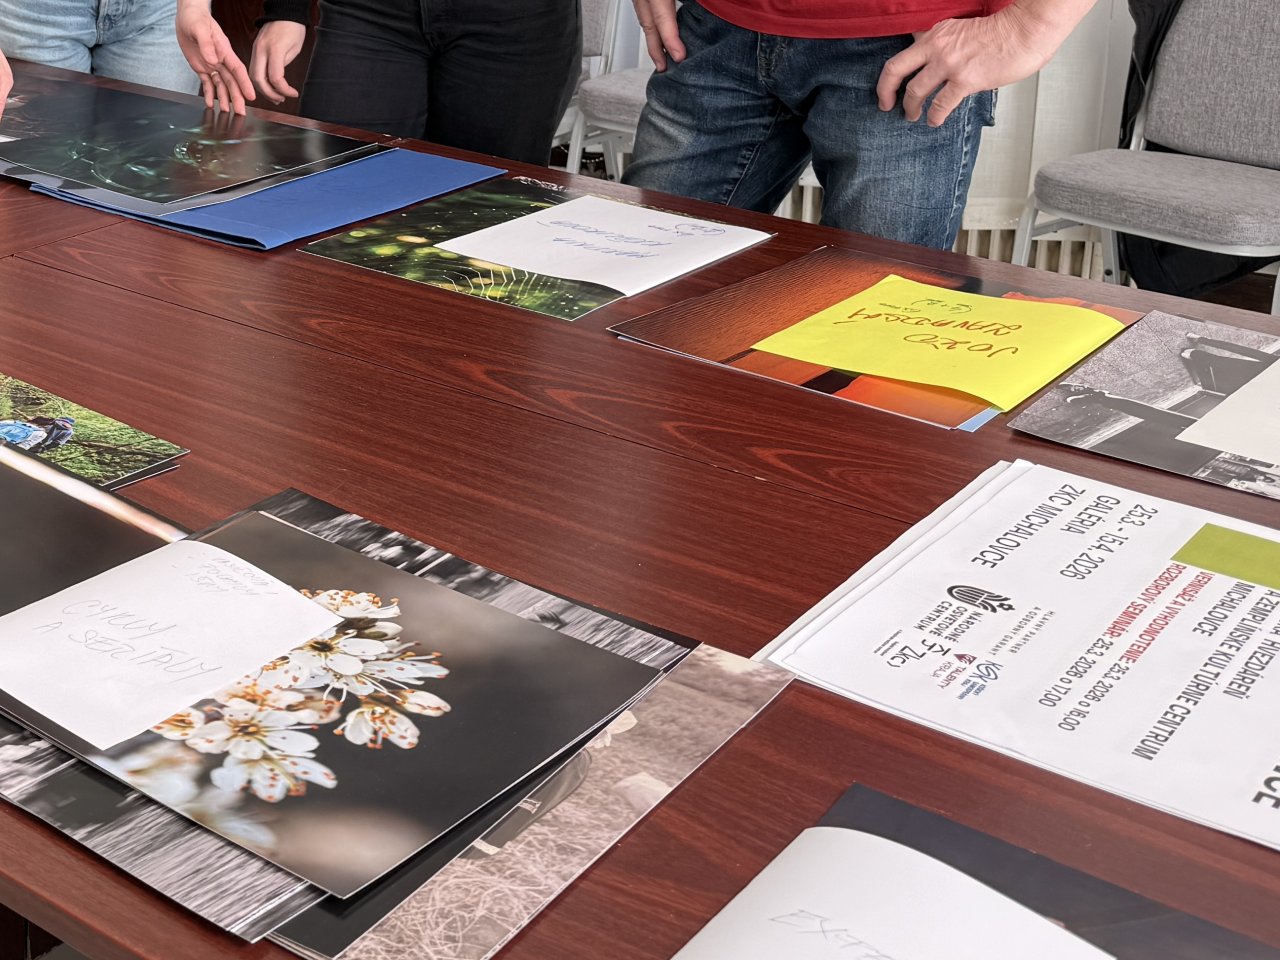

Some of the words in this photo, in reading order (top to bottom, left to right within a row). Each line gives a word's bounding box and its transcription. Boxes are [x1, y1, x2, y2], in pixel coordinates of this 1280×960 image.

[1048, 484, 1086, 506] ZKC
[1060, 495, 1121, 534] GALÉRIA
[1117, 504, 1159, 527] 25.3.
[971, 503, 1063, 569] MICHALOVCE
[1087, 532, 1129, 553] 15.4.
[1060, 552, 1105, 580] 2026
[1137, 562, 1188, 604] ROZBOROVÝ
[1175, 571, 1215, 602] VERNISÁŽ
[1264, 589, 1280, 598] A
[62, 600, 177, 637] CYKLY
[913, 600, 953, 631] CENTRUM
[928, 606, 968, 637] OSVETOVÉ
[1031, 610, 1056, 631] HLAVNÝ
[1102, 601, 1148, 639] SEMINÁR:
[1192, 581, 1256, 637] MICHALOVCE
[33, 621, 63, 634] A
[944, 610, 984, 643] NÁRODNÉ
[1010, 611, 1038, 635] ODBORNÝ
[1120, 606, 1182, 664] VYHODNOTENIE:
[1219, 596, 1280, 652] ZEMPLÍNSKE
[988, 634, 1013, 655] GARANT
[1008, 631, 1036, 654] PARTNER
[930, 661, 953, 678] KRAJA
[937, 666, 967, 689] TALENTY
[1066, 656, 1097, 678] 2026
[1176, 649, 1236, 706] KULTÚRNE
[1223, 638, 1280, 700] HVEZDÁREŇ
[1039, 683, 1072, 707] 17,00
[1078, 700, 1090, 708] o
[1084, 680, 1113, 702] 2026
[1058, 708, 1090, 731] 16,00
[1131, 703, 1191, 761] CENTRUM
